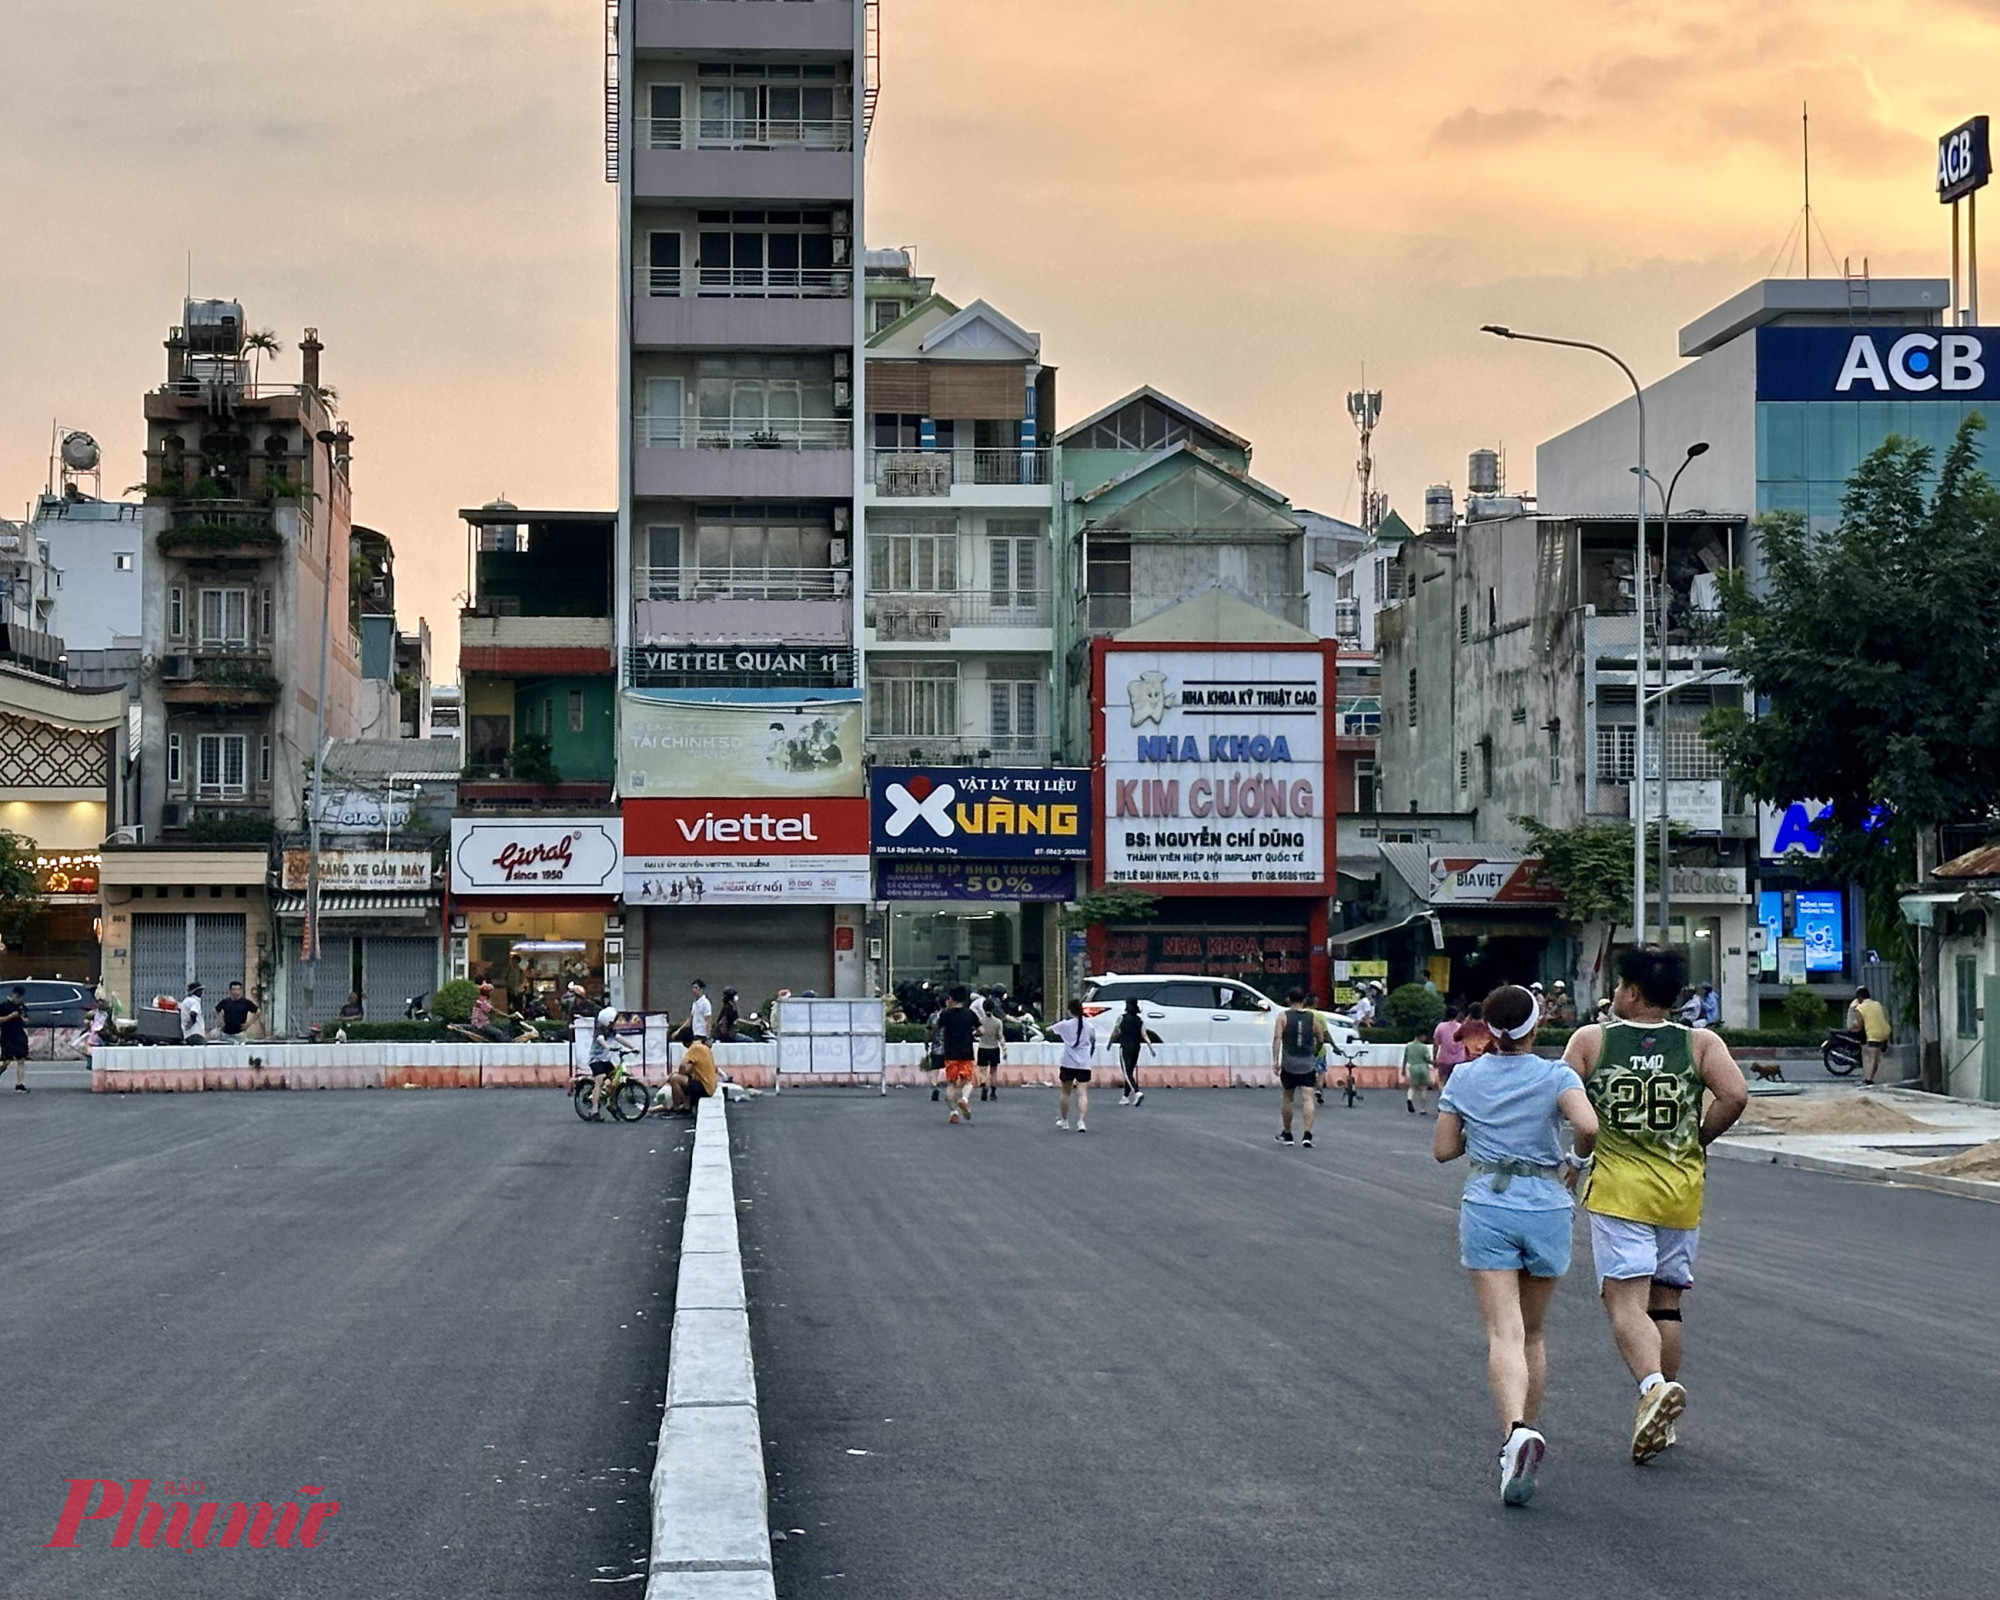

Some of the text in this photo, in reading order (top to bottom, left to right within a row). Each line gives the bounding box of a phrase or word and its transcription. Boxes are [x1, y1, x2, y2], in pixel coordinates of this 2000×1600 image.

[1937, 129, 1971, 187] ACB
[1835, 333, 1985, 391] ACB
[645, 652, 728, 671] VIETTEL
[819, 653, 838, 671] 11
[1182, 690, 1204, 705] NHA
[1207, 690, 1236, 705] KHOA
[1256, 688, 1292, 707] THUẬT
[1294, 691, 1317, 705] CAO
[1137, 735, 1292, 763] NHA KHOA
[957, 775, 1076, 794] VẬT LÝ TRỊ LIỆU
[1116, 771, 1313, 818] KIM CƯƠNG
[342, 811, 381, 827] GIAO
[675, 812, 818, 842] viettel
[1125, 826, 1304, 848] BS: NGUYỄN CHÍ DŨNG
[352, 863, 369, 876] XE
[401, 862, 425, 876] MÁY
[513, 869, 563, 880] since 1950
[763, 879, 783, 892] NỐI
[1163, 937, 1202, 956] NHA
[1206, 937, 1260, 956] KHOA
[1610, 1073, 1680, 1133] 26
